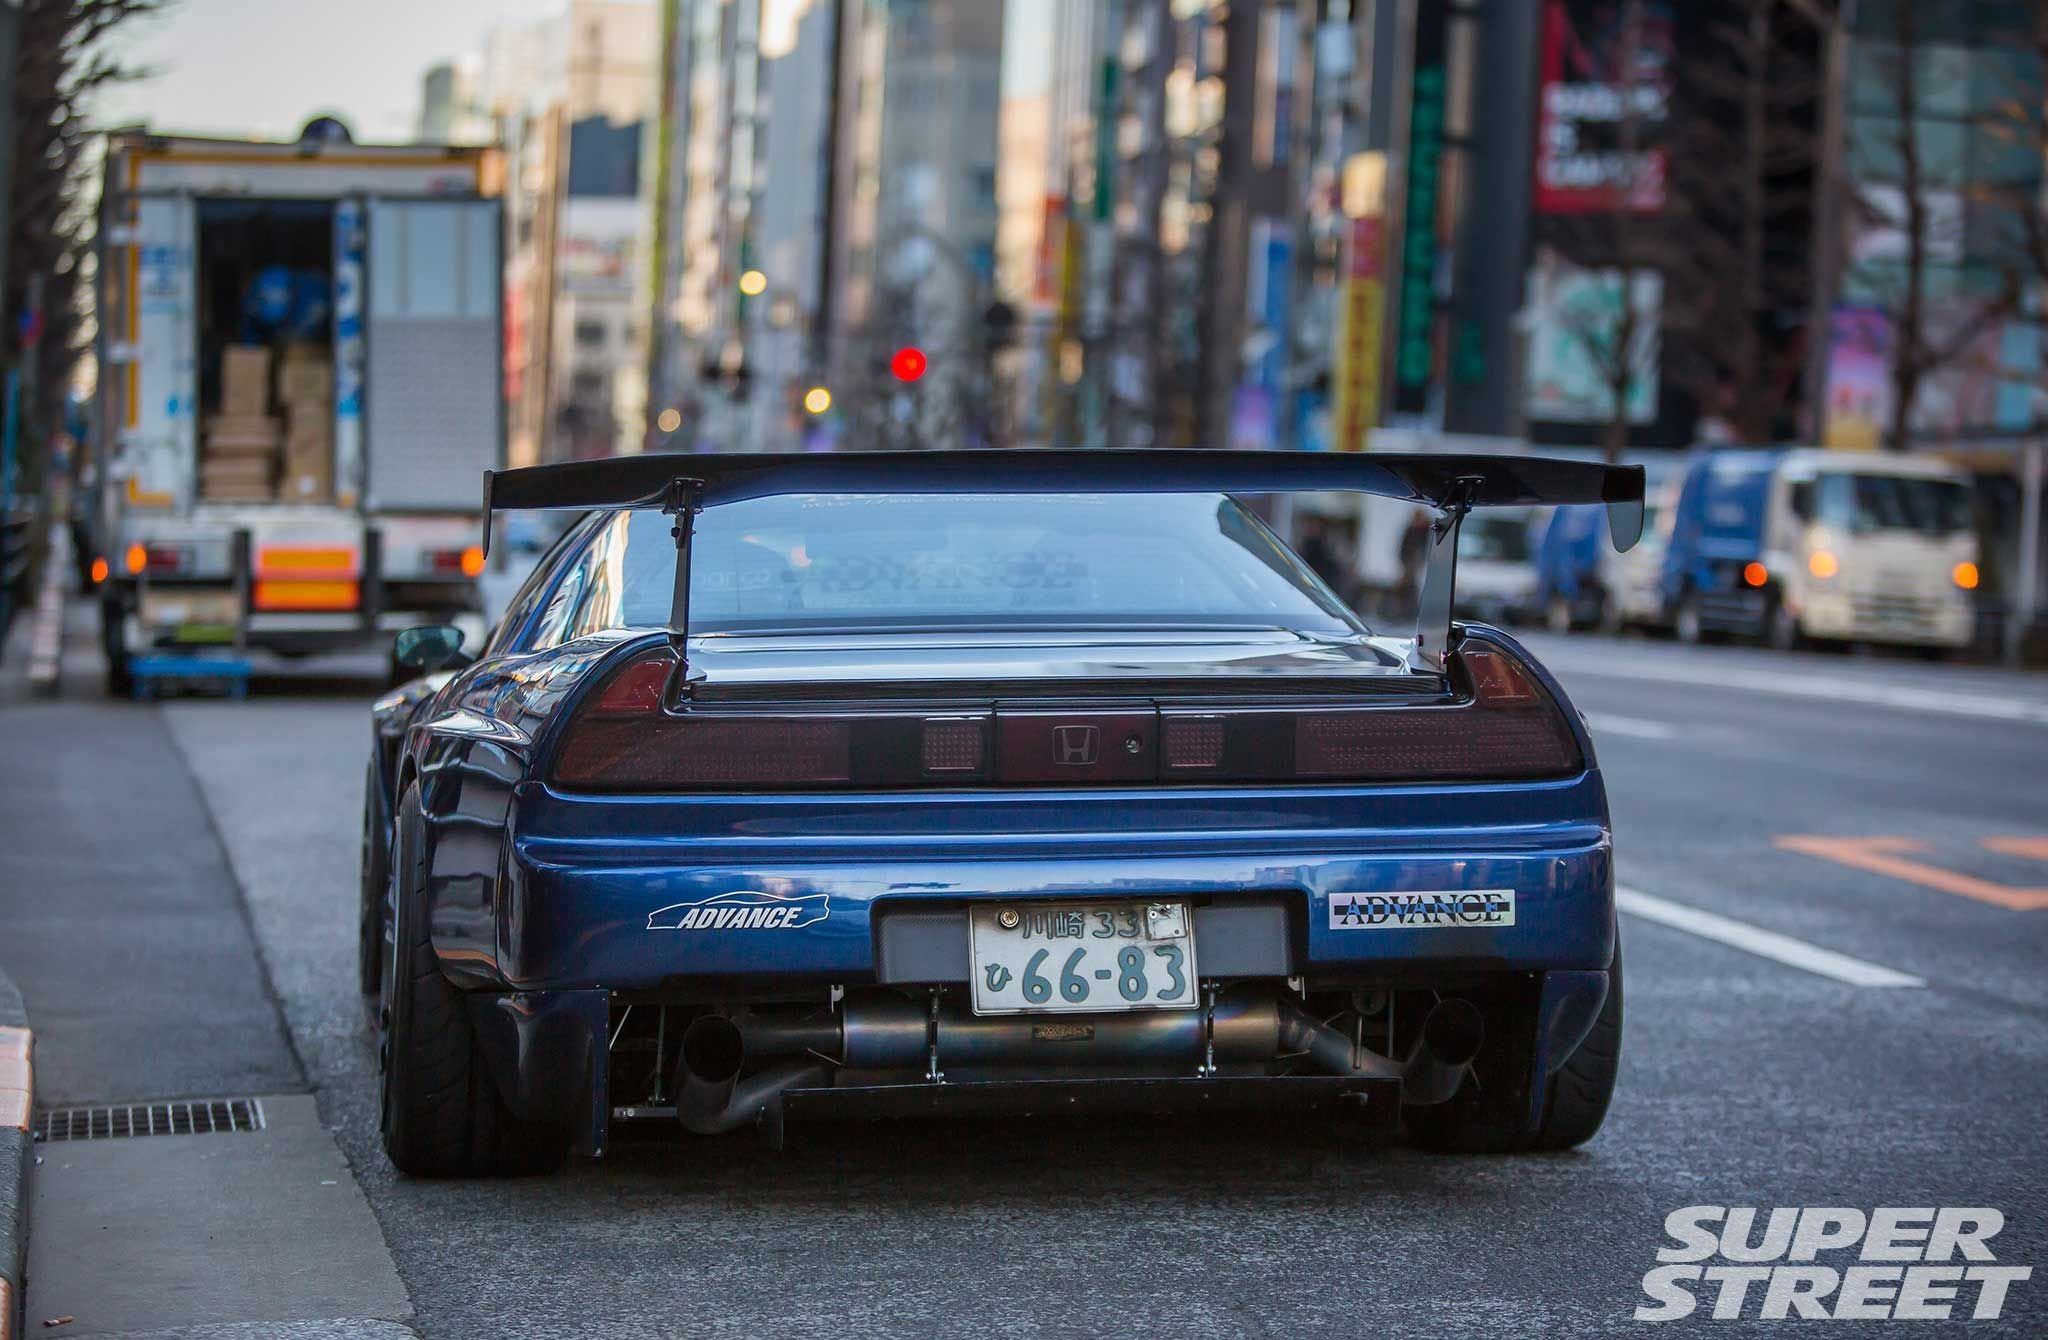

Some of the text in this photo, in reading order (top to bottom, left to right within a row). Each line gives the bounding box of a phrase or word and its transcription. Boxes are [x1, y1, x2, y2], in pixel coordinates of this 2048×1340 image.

[677, 907, 803, 929] ADVANCE
[1340, 893, 1504, 925] ADVANCE
[1022, 911, 1085, 939] 川崎
[1092, 911, 1140, 938] 33
[984, 945, 1186, 1004] ひ 66-83
